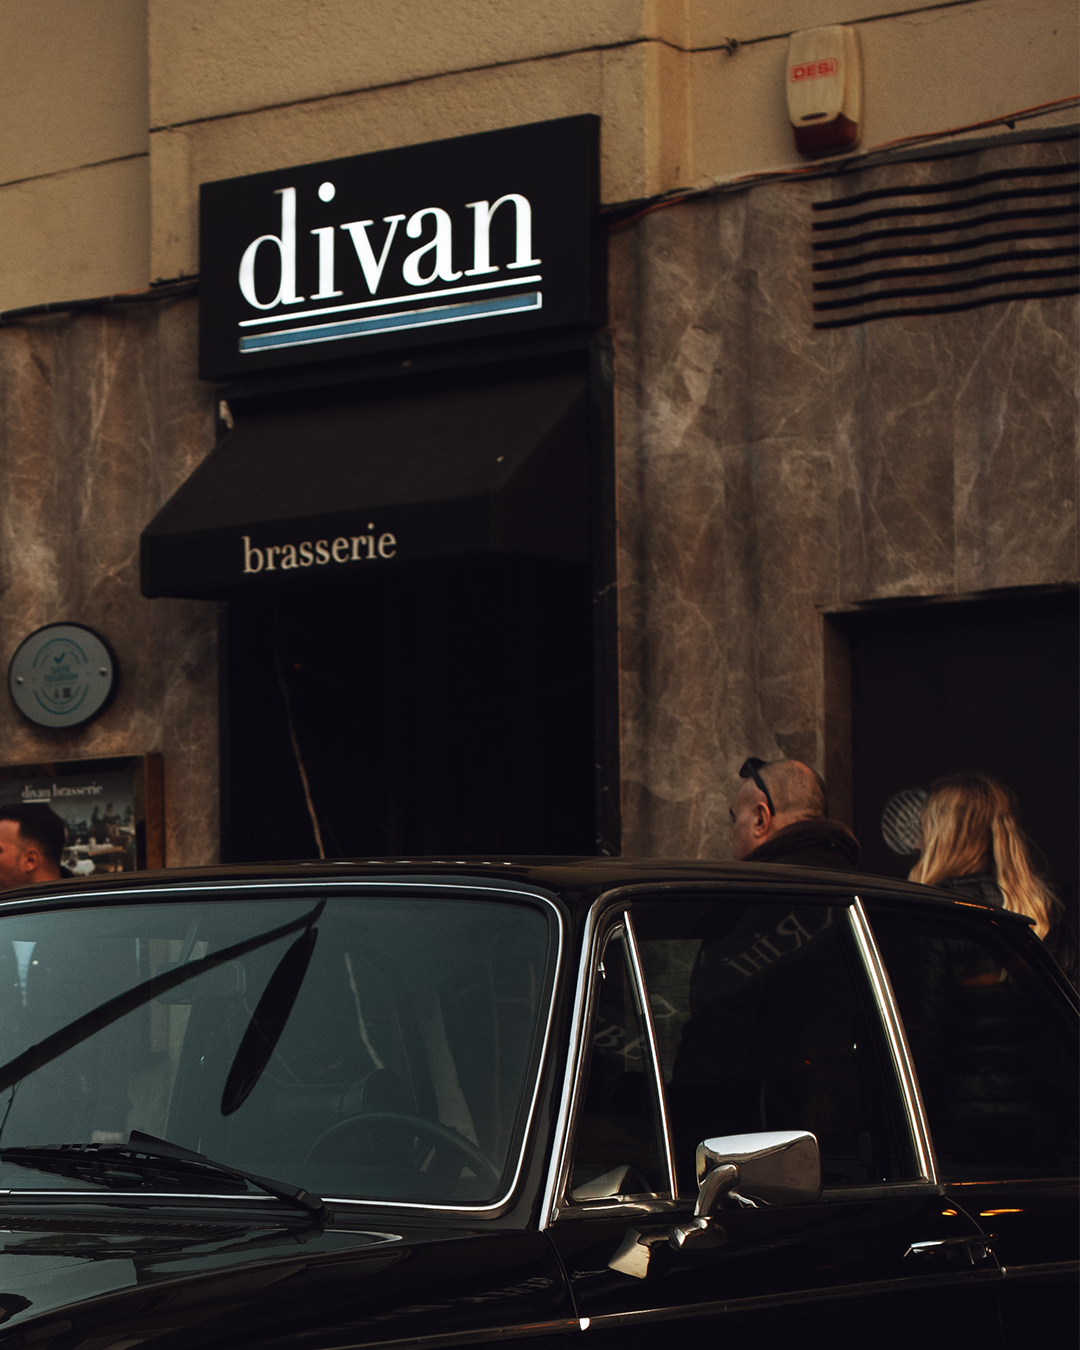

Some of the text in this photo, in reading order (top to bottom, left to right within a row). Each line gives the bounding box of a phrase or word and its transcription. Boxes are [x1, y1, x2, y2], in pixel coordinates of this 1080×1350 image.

[238, 181, 542, 310] divan
[241, 523, 398, 575] brasserie
[21, 781, 104, 798] divan brasserie
